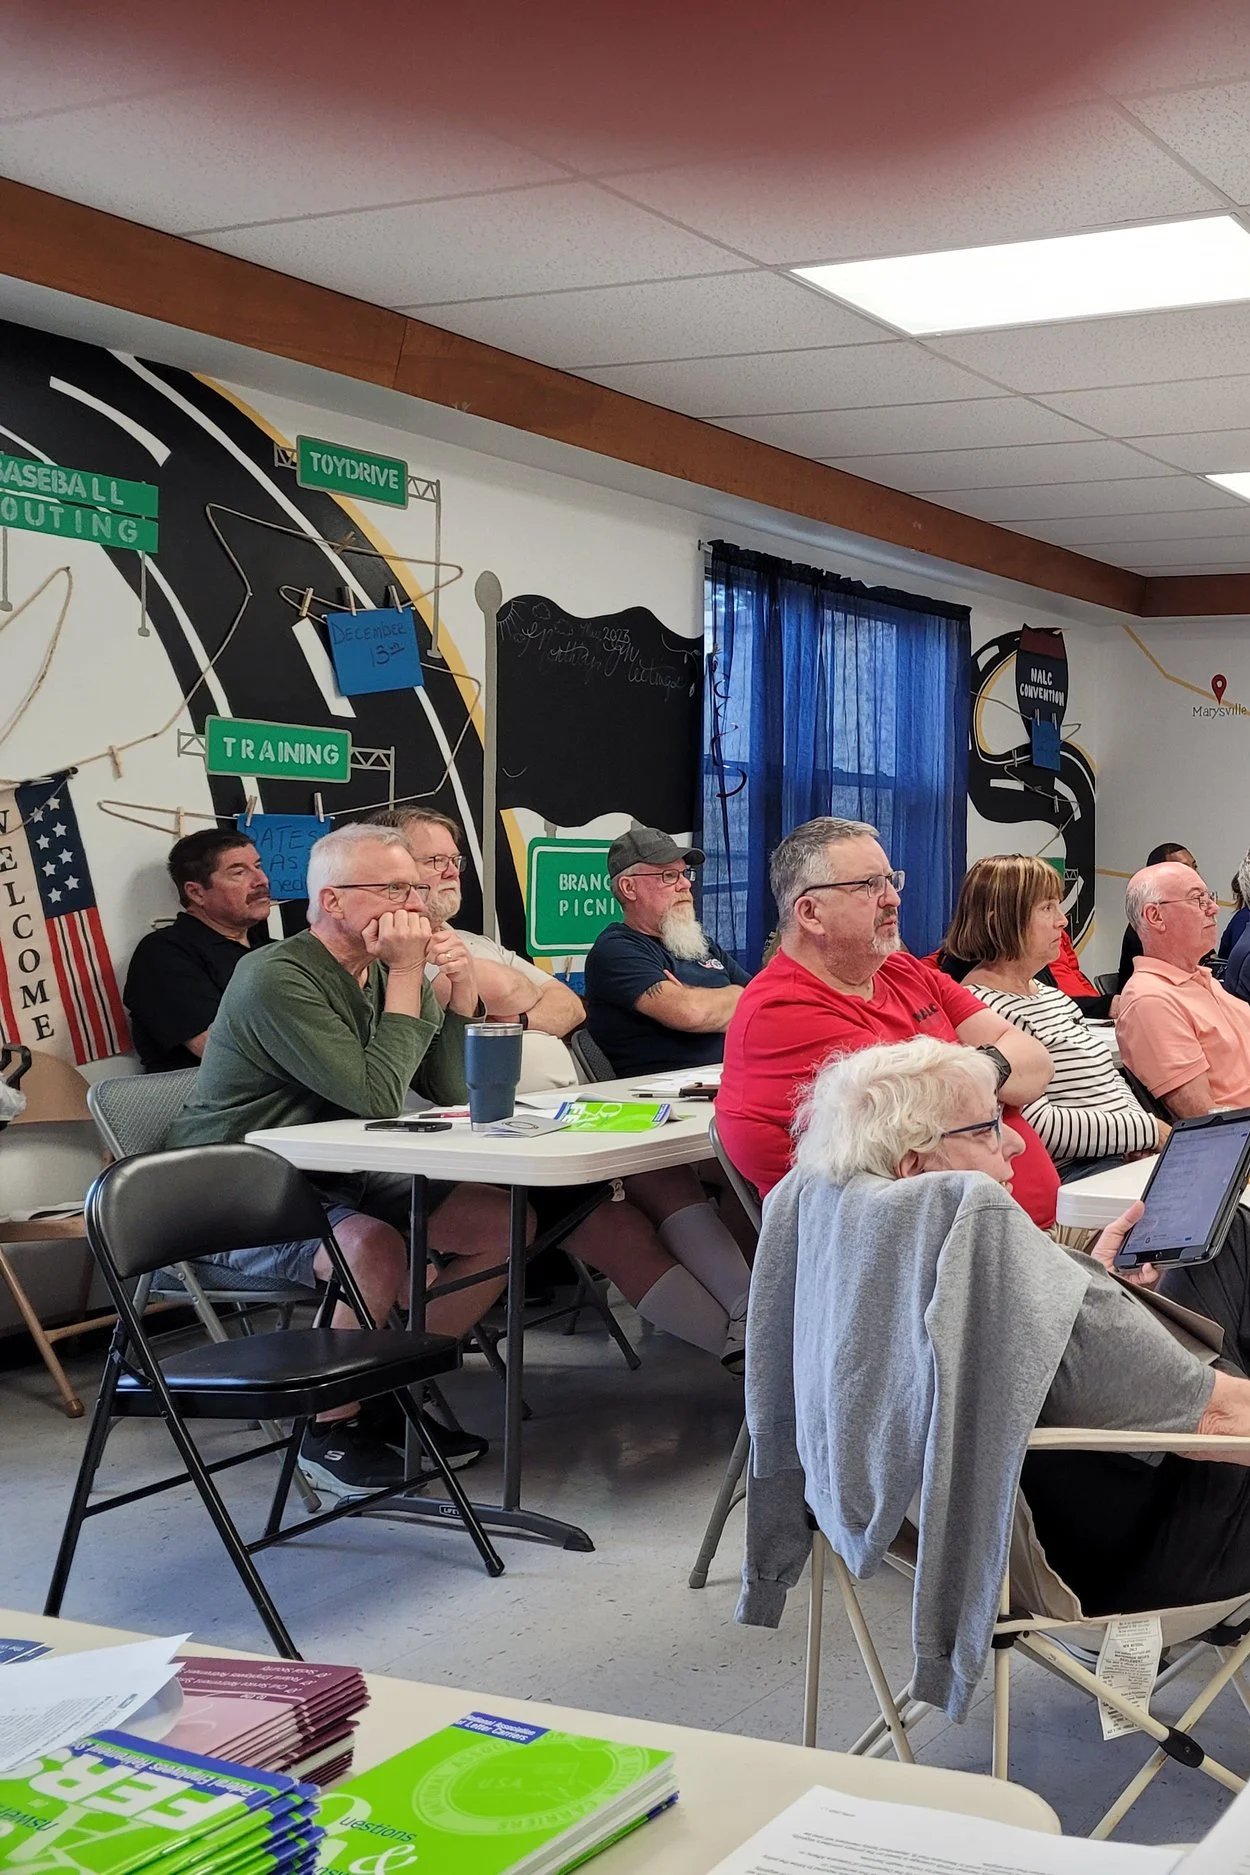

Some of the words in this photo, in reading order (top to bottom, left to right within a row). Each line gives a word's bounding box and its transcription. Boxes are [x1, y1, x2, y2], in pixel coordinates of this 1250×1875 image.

[309, 451, 399, 489] TOYDRIVE
[0, 496, 138, 543] OUTING
[1031, 667, 1053, 686] NALC
[1019, 682, 1065, 707] CONVENTION
[1192, 703, 1248, 719] Marysville
[223, 736, 340, 765] TRAINING
[560, 873, 611, 892] BRANC
[560, 897, 623, 916] PICNI
[491, 1728, 529, 1741] Carriers
[0, 1748, 248, 1832] FER
[207, 1777, 261, 1797] Federal
